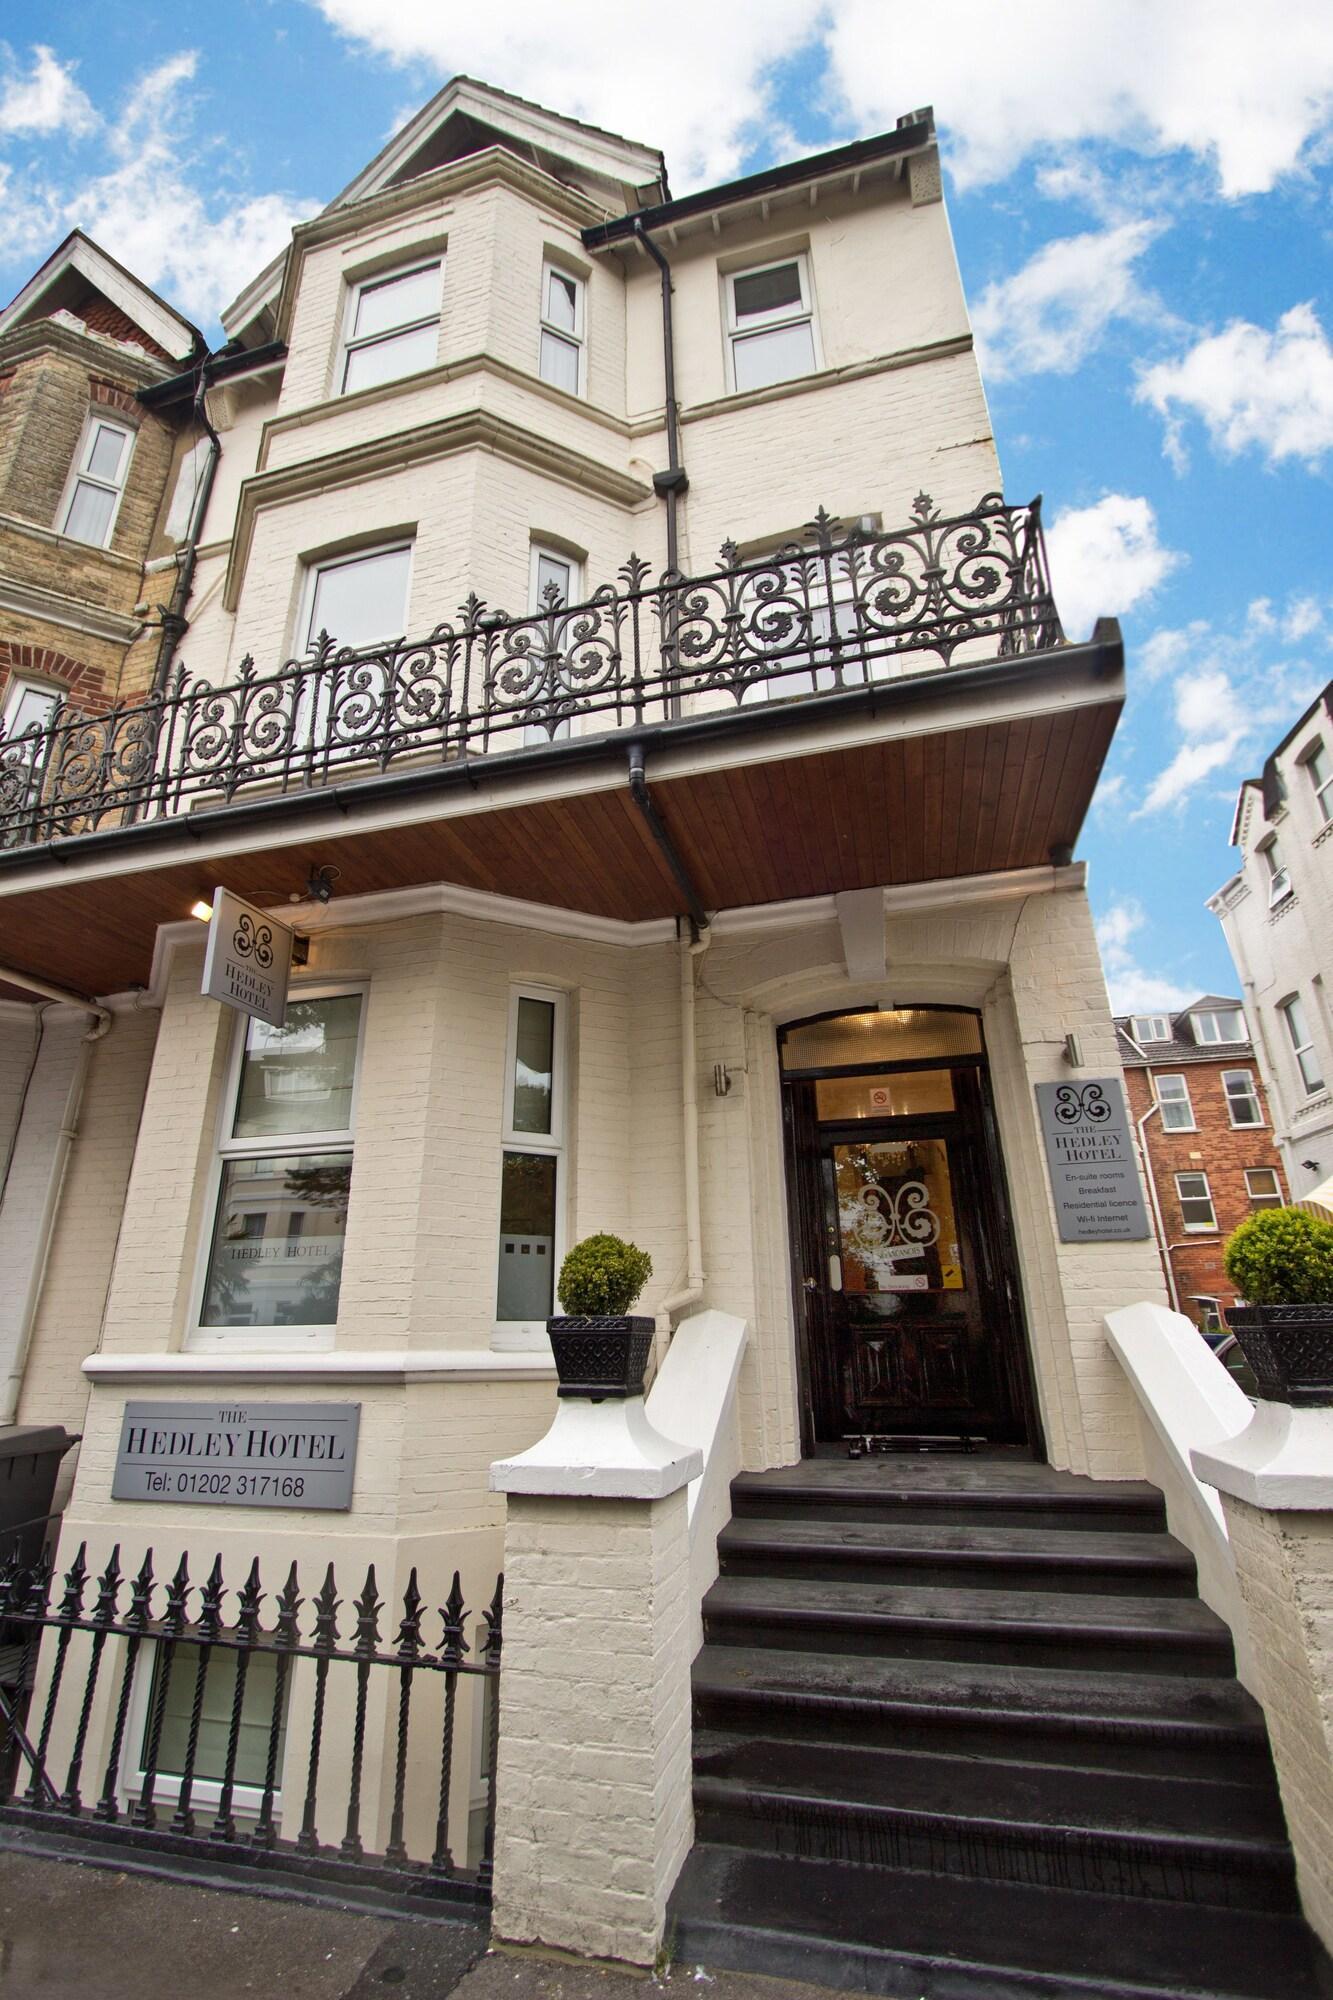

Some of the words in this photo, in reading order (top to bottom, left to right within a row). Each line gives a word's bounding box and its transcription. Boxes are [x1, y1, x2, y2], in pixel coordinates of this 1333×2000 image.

[225, 963, 274, 997] HEDLEY
[230, 981, 269, 1010] HOTEL
[1073, 1125, 1097, 1135] THE
[1056, 1135, 1122, 1149] HEDLEY
[1066, 1149, 1122, 1162] HOTEL
[1065, 1173, 1097, 1182] En-suite
[1099, 1172, 1125, 1180] rooms
[1078, 1186, 1117, 1195] Breakfast
[1063, 1201, 1107, 1209] Residential
[1076, 1215, 1096, 1223] Wi-fi
[231, 1247, 280, 1260] HEDLEY
[287, 1245, 330, 1258] HOTEL
[219, 1410, 247, 1424] THE
[126, 1427, 241, 1457] HEDLEY
[243, 1429, 345, 1460] HOTEL
[145, 1471, 171, 1492] Tel:
[177, 1473, 230, 1495] 01202
[236, 1475, 305, 1498] 317168
